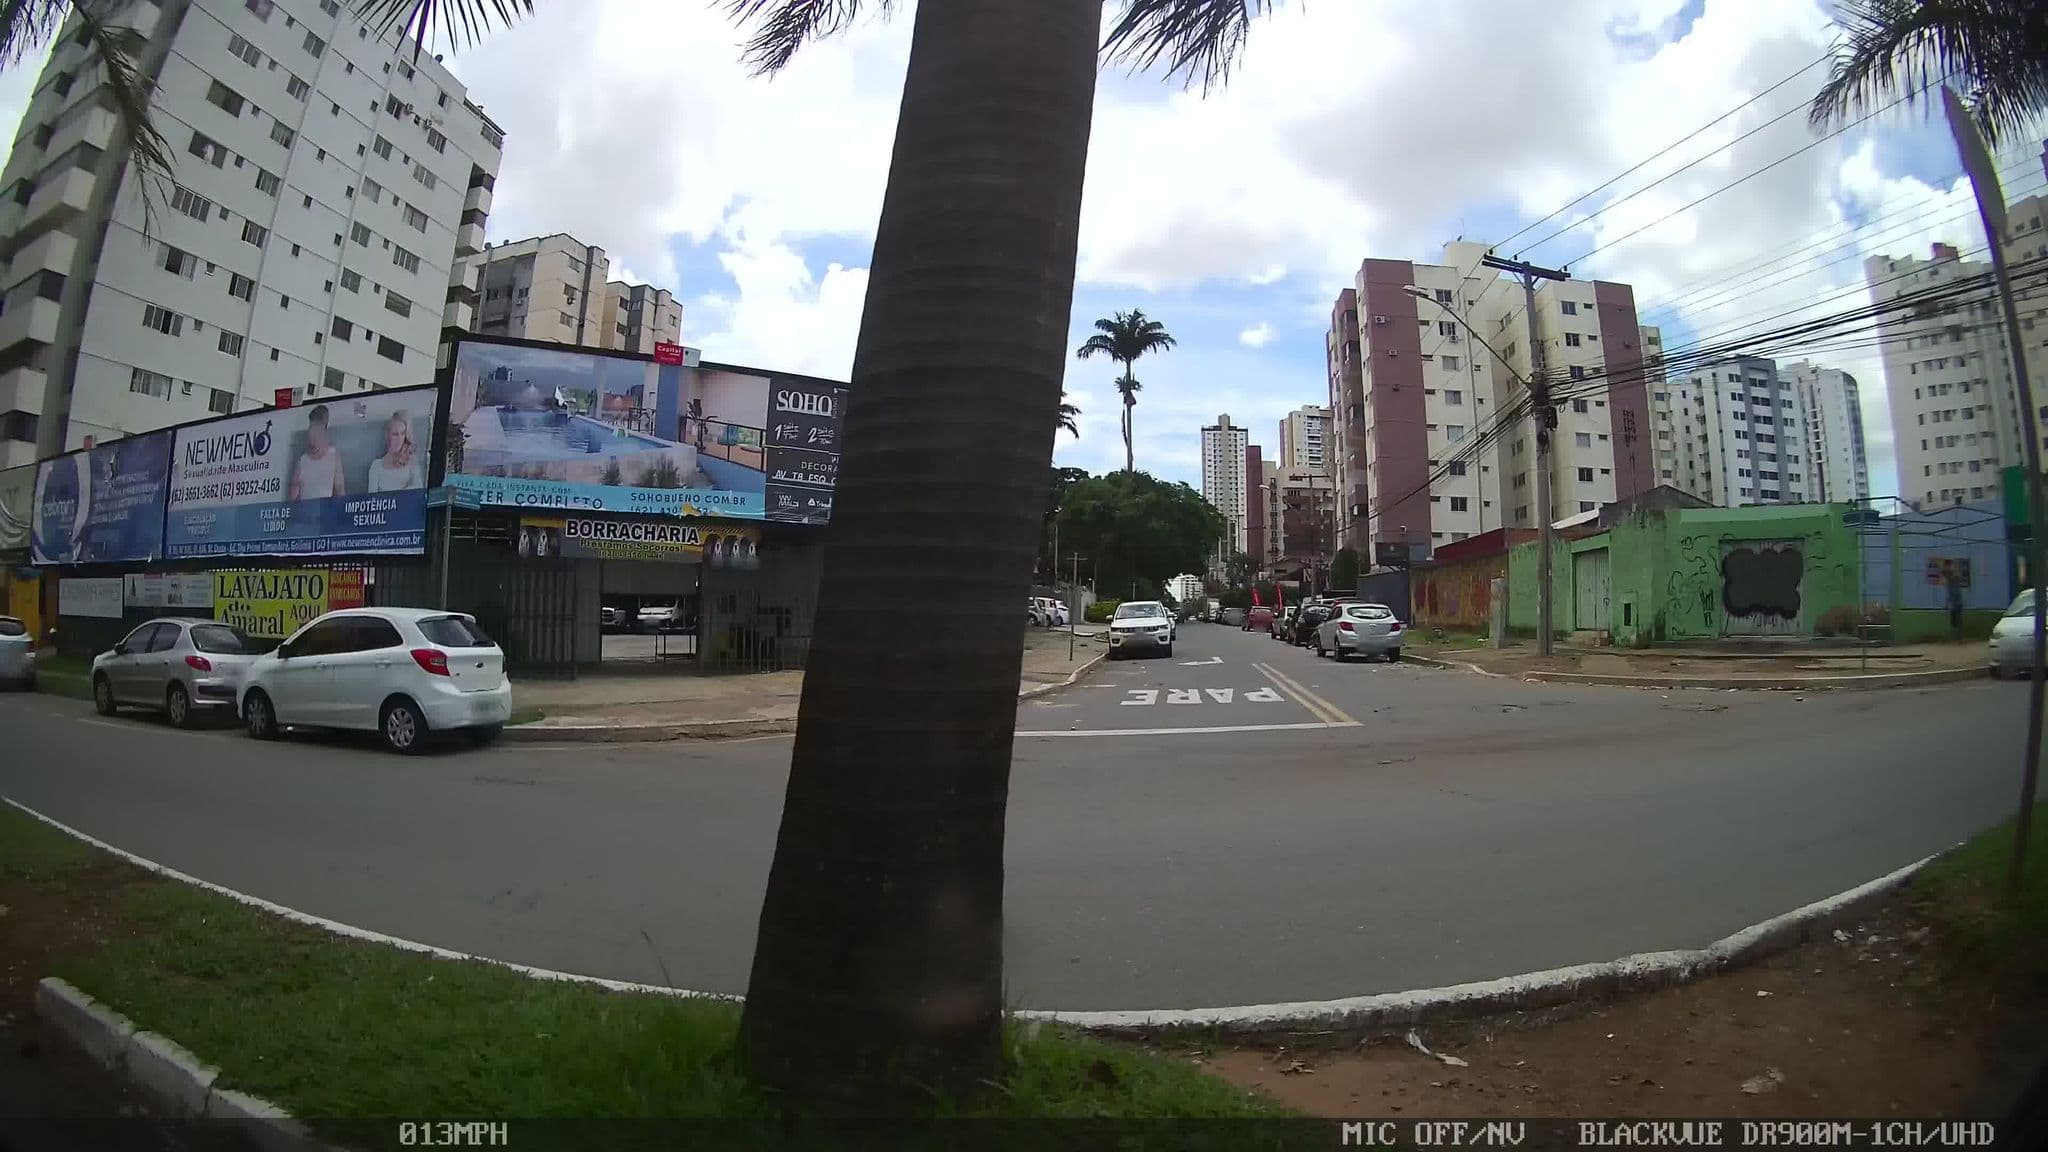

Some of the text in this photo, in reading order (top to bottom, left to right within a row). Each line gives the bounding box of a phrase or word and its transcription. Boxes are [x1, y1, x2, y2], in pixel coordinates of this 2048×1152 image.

[776, 390, 832, 417] SOHO
[228, 461, 269, 474] Masculina
[171, 486, 184, 504] (62)
[220, 481, 234, 502] (62)
[236, 478, 280, 496] 99252-4168
[479, 490, 504, 503] ZER
[260, 507, 291, 519] FALTA DE
[345, 498, 397, 513] IMPOTÊNCIA
[353, 513, 386, 526] SEXUAL
[566, 519, 699, 544] BORRACHARIA
[219, 574, 324, 600] LAVAJATO
[221, 608, 284, 635] Amaral
[1120, 687, 1285, 706] PARE
